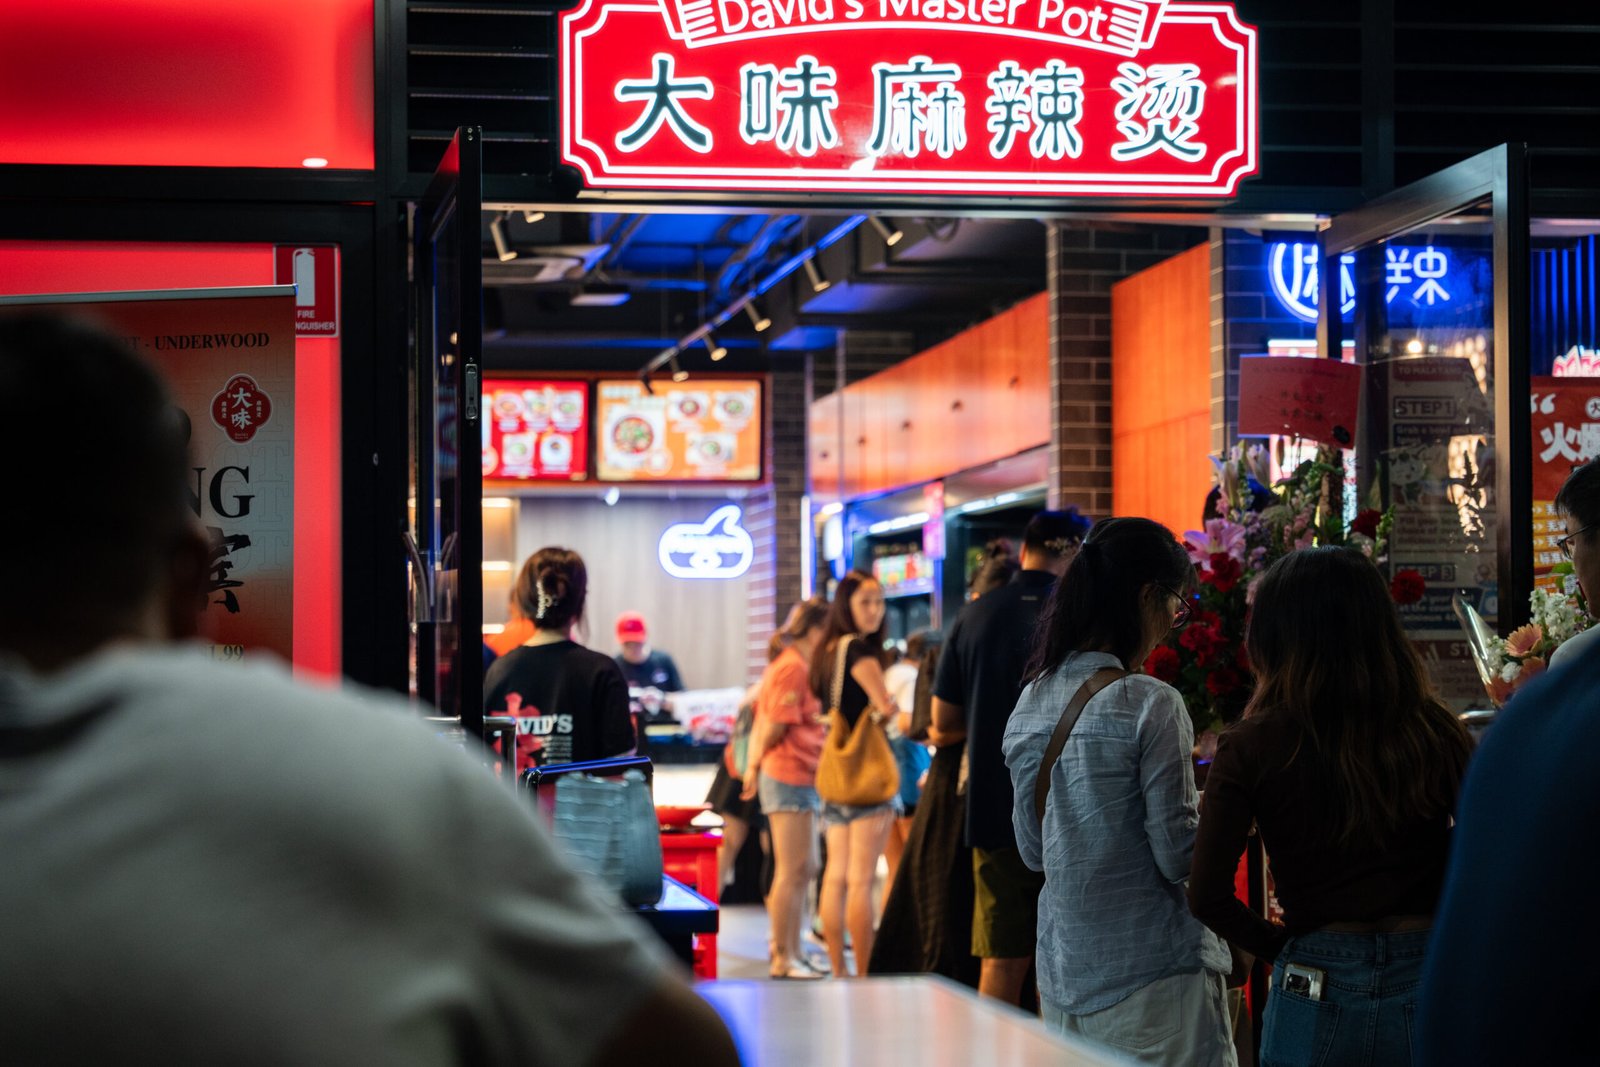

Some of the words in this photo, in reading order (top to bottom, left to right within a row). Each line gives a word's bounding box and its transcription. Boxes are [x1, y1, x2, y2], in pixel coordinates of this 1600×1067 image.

[718, 0, 863, 33] Davids
[1037, 0, 1107, 42] Pot
[613, 53, 1208, 162] 大味麻辣烫
[297, 309, 316, 319] FIRE
[154, 332, 270, 351] UNDERWOOD
[231, 387, 253, 431] 大味
[1397, 401, 1442, 415] STEP
[1444, 401, 1451, 415] 1
